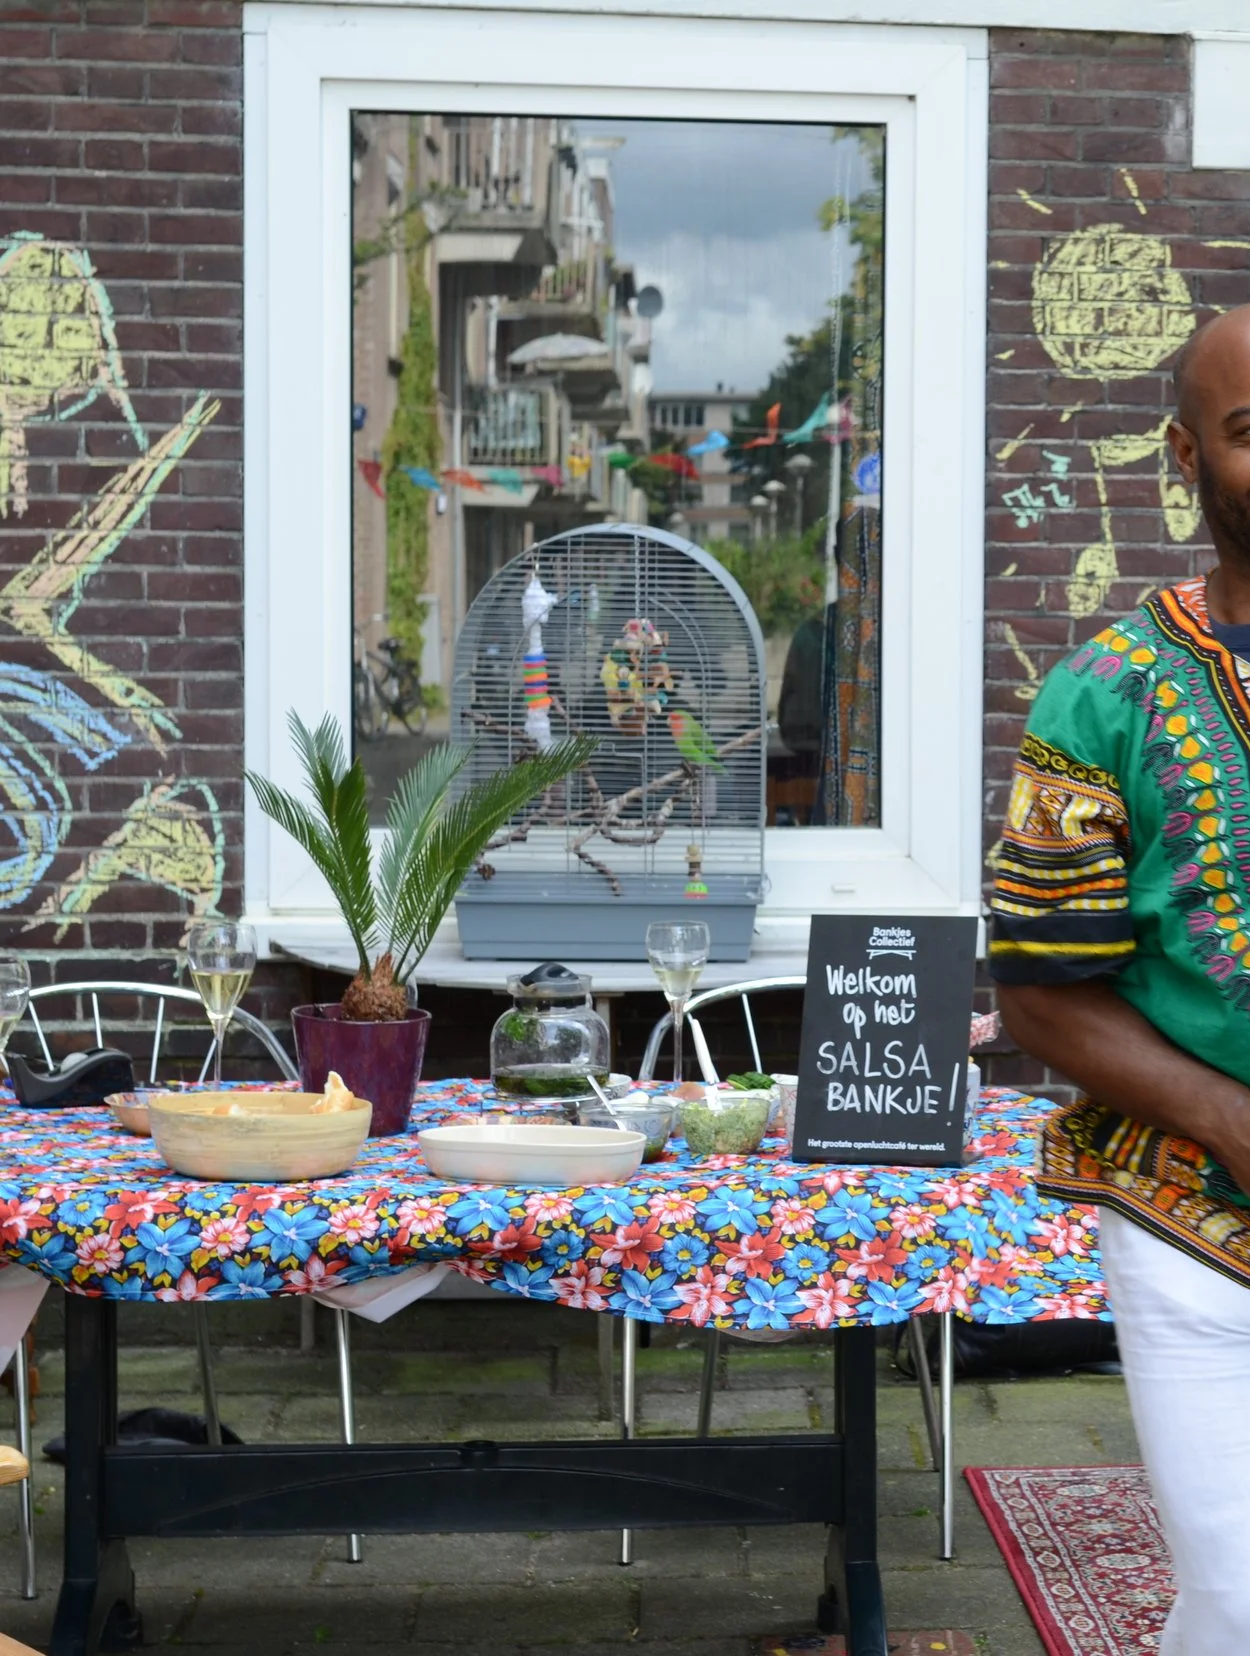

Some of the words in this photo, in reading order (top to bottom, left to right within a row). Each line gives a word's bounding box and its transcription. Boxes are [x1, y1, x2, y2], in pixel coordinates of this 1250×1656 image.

[869, 936, 916, 946] Collectief
[873, 926, 911, 938] Bankjes
[826, 964, 917, 998] Welkom
[874, 999, 915, 1026] het
[816, 1040, 932, 1079] SALSA
[807, 1138, 821, 1147] Het
[822, 1140, 852, 1149] grootste
[907, 1142, 918, 1150] ter
